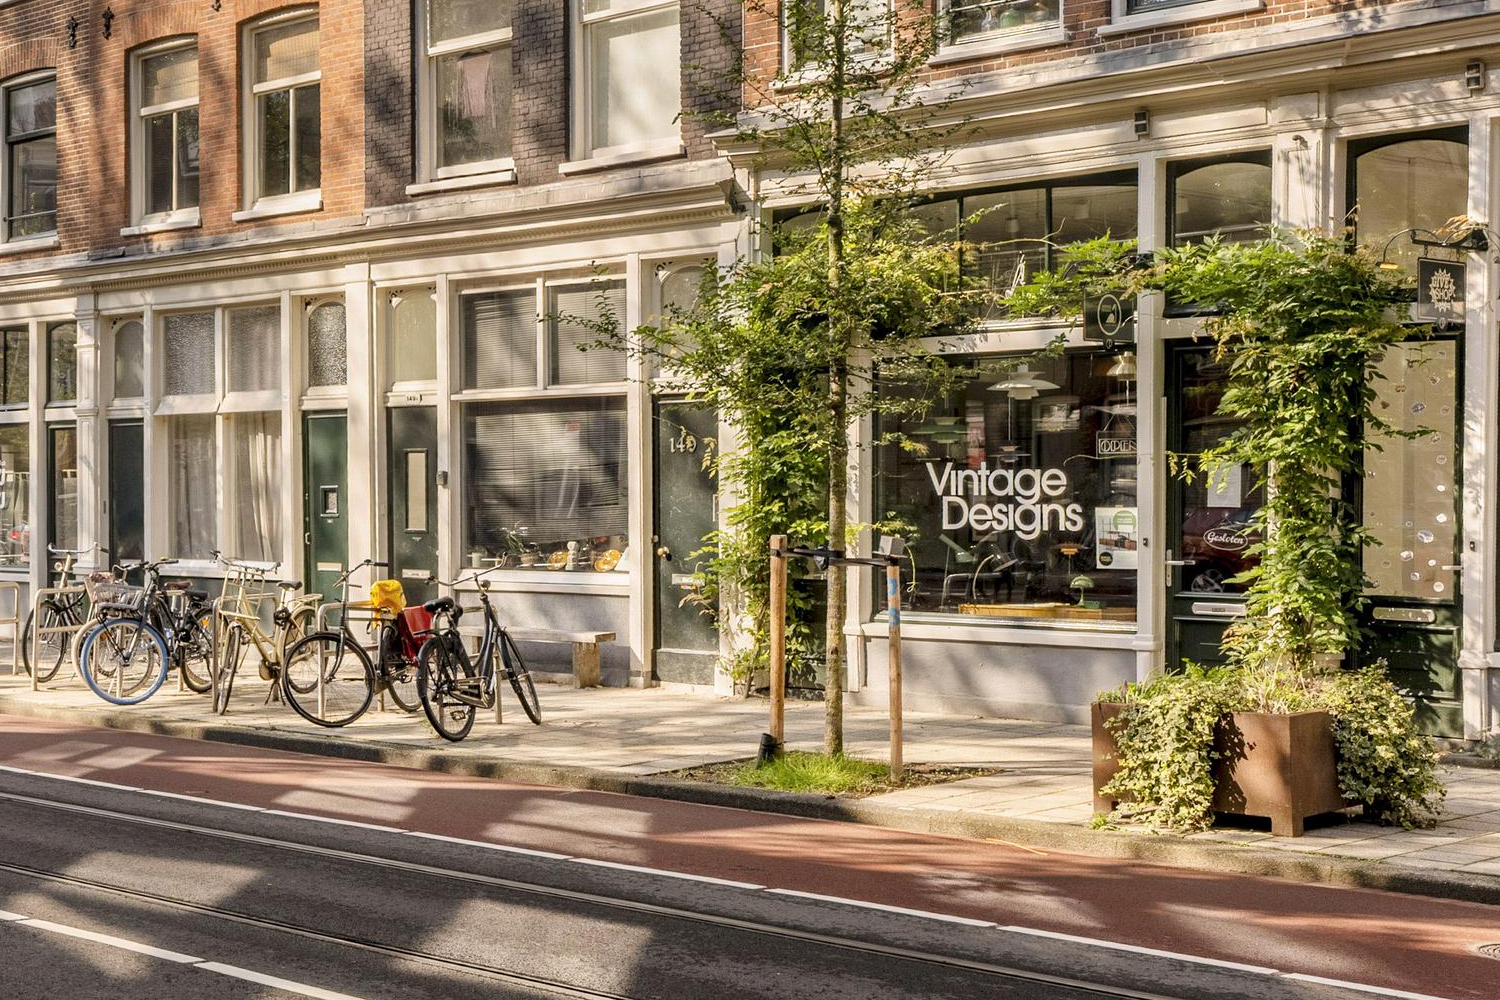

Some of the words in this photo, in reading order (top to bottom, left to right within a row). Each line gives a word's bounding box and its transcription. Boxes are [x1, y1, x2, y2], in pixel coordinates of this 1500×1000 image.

[926, 461, 1067, 504] Vintage
[942, 496, 1084, 541] Designs
[1207, 531, 1245, 545] Gesloten
